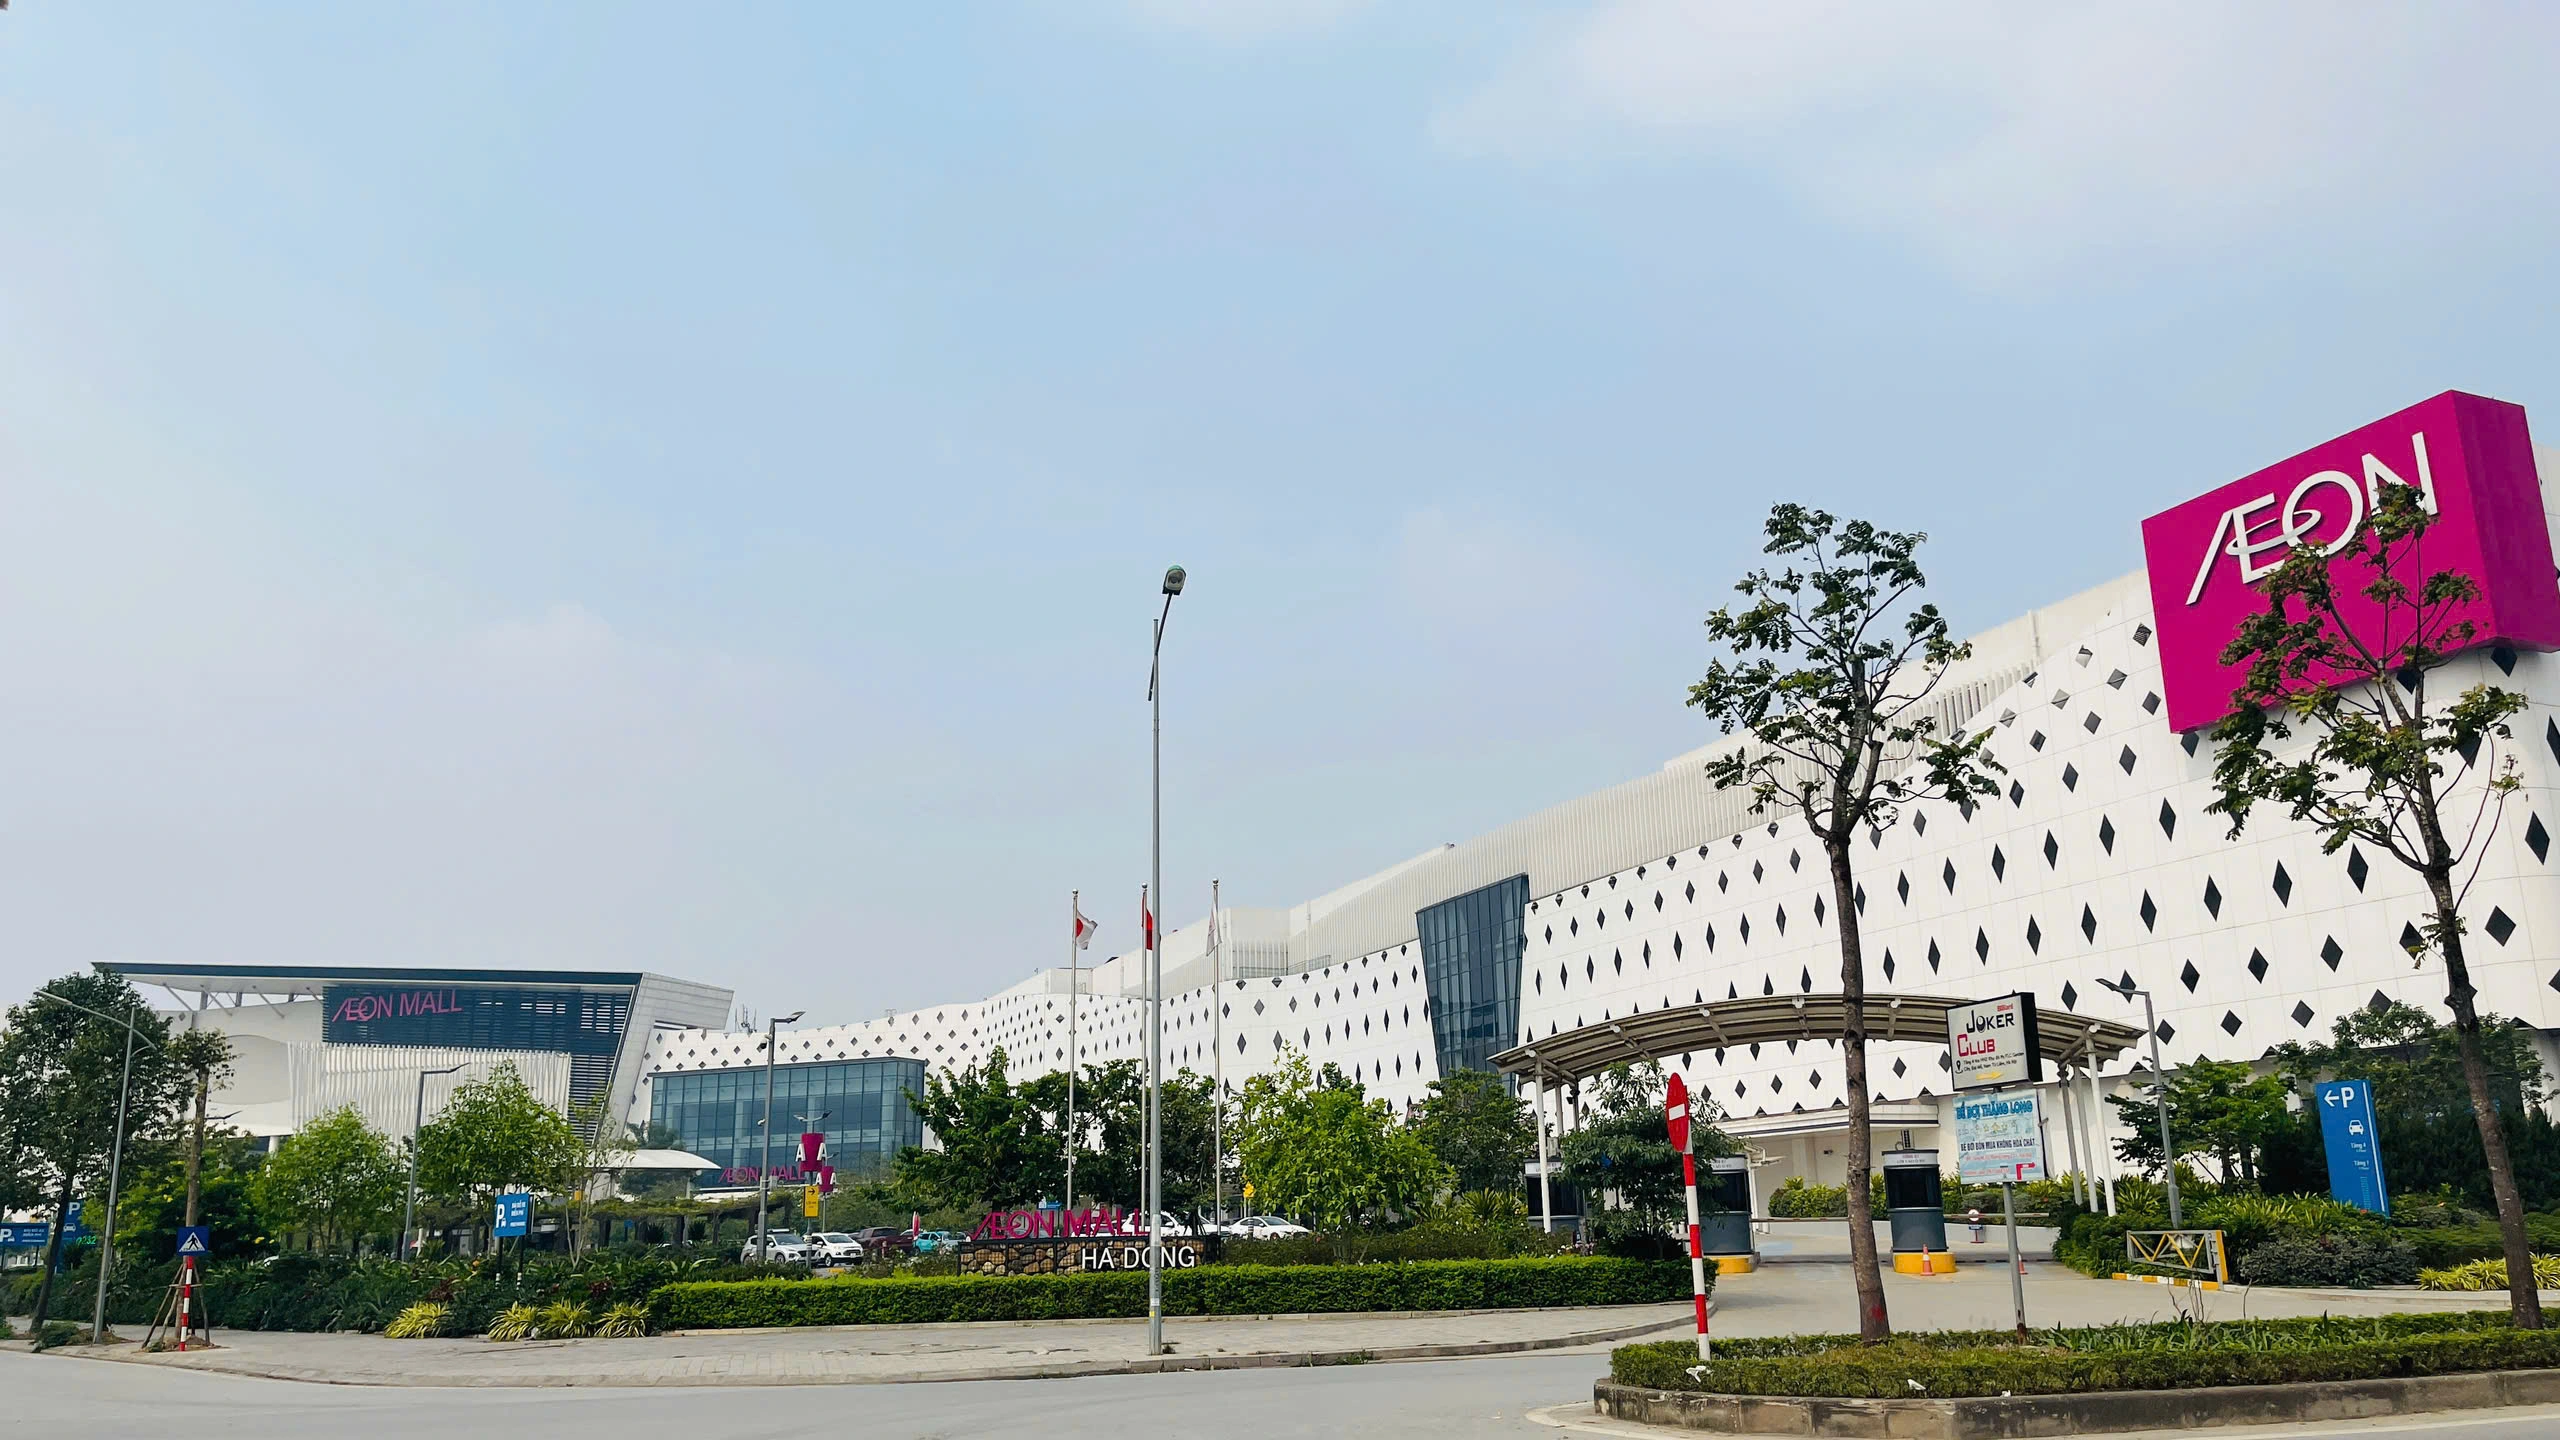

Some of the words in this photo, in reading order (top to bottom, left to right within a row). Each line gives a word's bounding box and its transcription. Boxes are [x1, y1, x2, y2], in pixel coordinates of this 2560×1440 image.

[400, 988, 462, 1016] MALL
[1966, 1009, 2015, 1033] JOKER
[1957, 1033, 1995, 1057] CLUB
[2010, 1100, 2033, 1114] LONG
[2341, 1086, 2355, 1108] P
[69, 1202, 80, 1215] P
[496, 1203, 505, 1228] P
[1062, 1208, 1150, 1237] MALL
[0, 1229, 12, 1242] P
